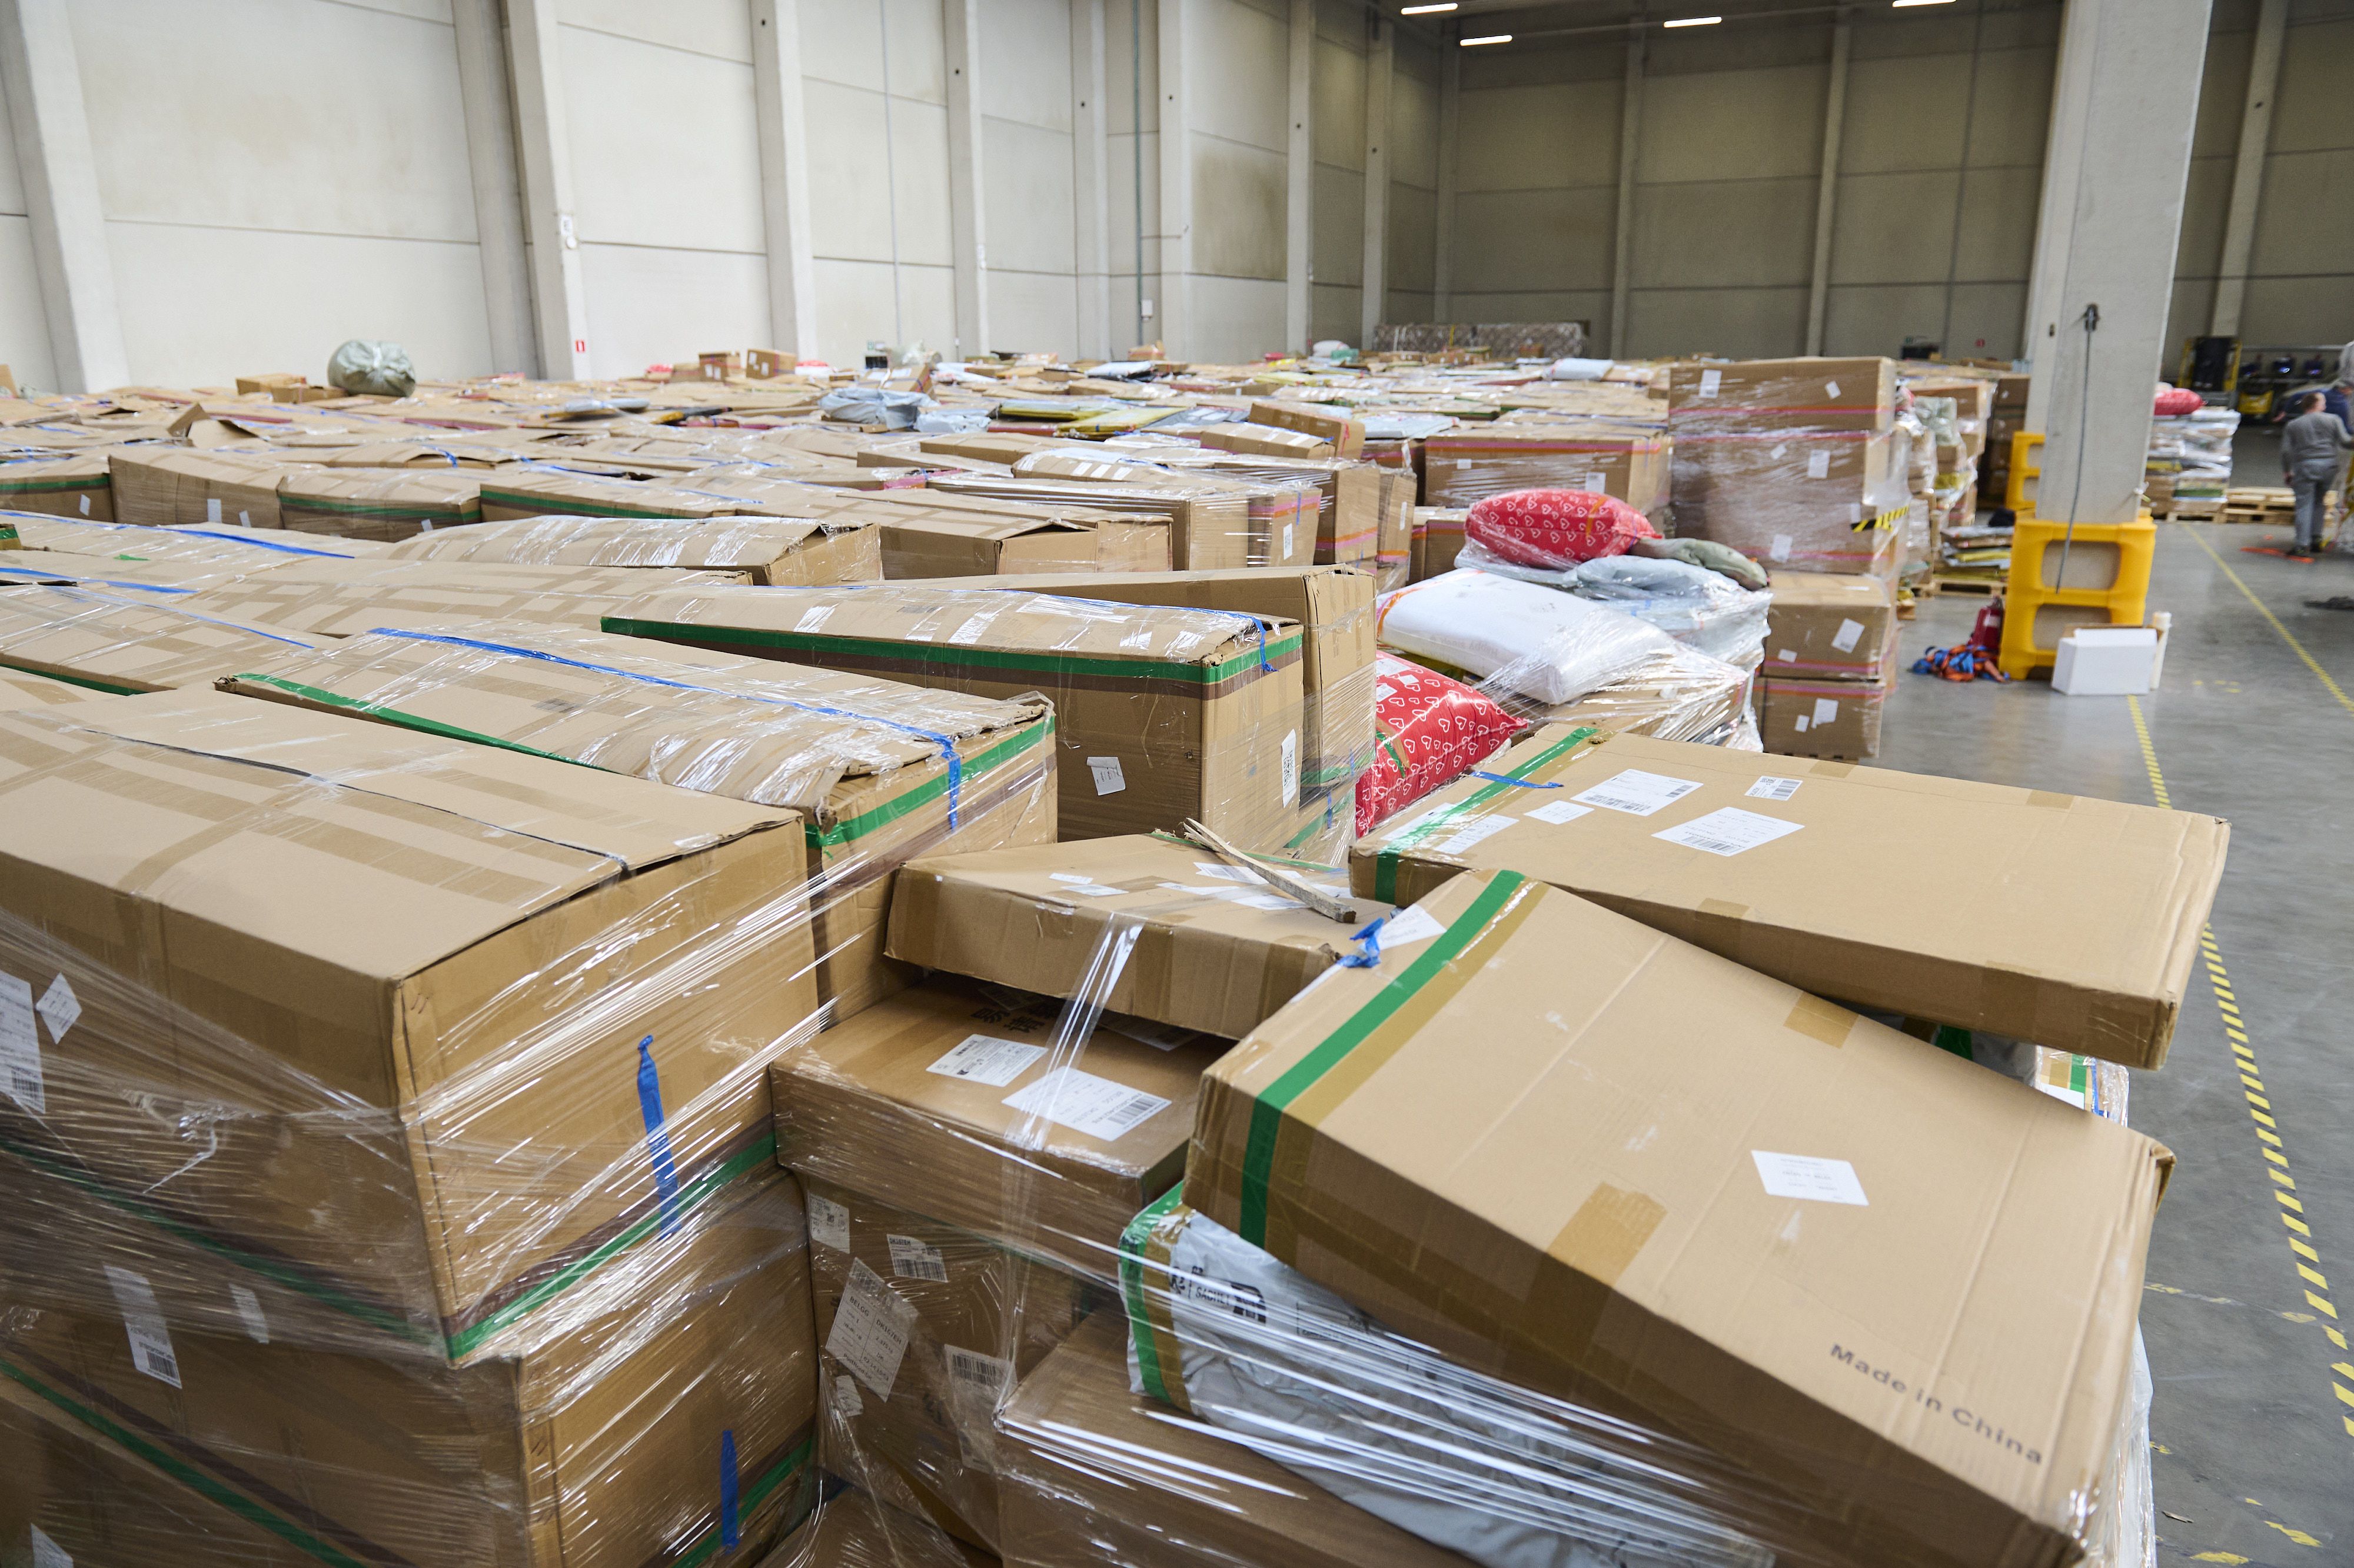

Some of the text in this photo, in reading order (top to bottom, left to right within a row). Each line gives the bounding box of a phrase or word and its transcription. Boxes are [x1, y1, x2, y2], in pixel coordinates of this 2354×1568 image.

[1830, 1344, 2042, 1464] Made in China
